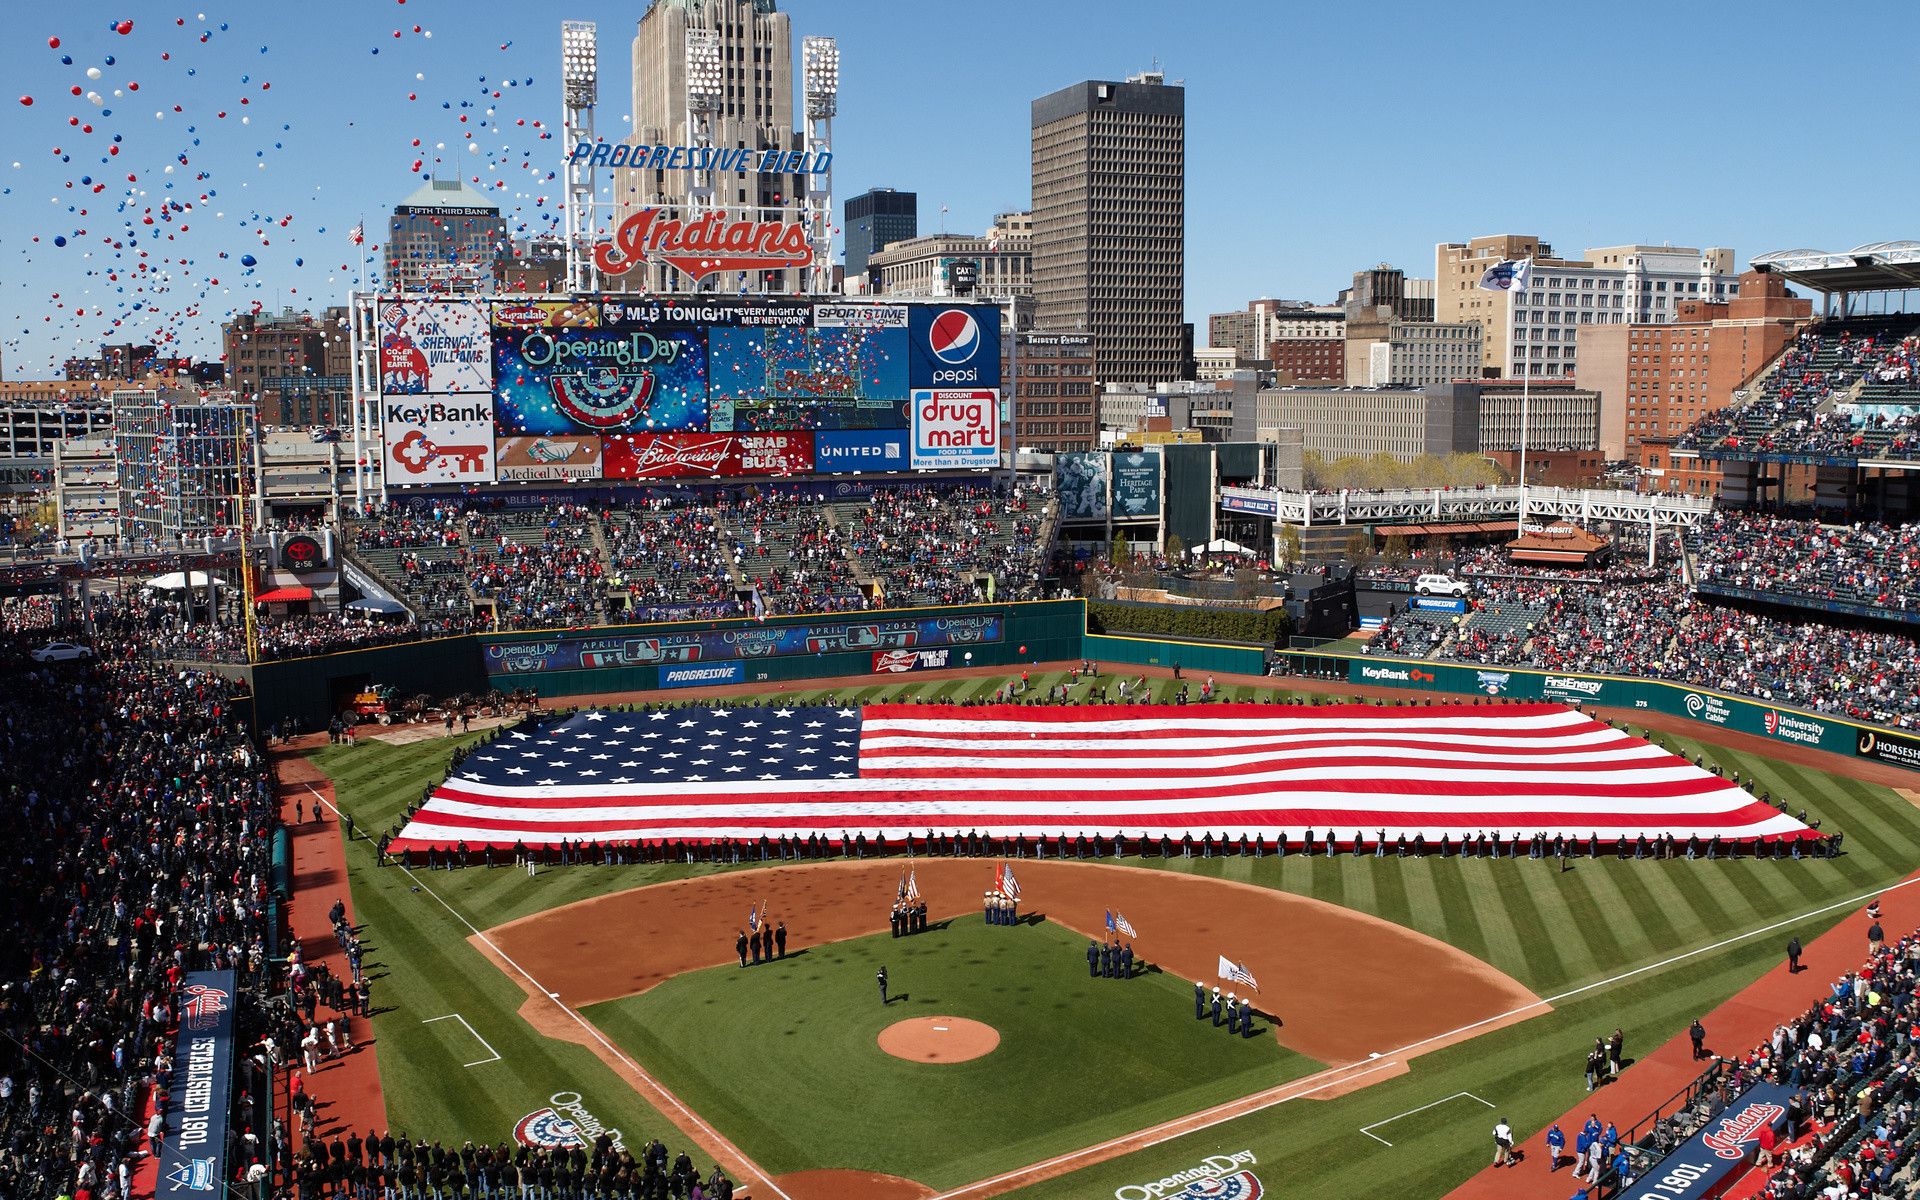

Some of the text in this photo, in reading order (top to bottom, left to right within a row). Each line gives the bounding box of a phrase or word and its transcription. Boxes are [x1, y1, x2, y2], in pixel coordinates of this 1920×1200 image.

[569, 143, 833, 174] PROGRESSIVE FIELD
[435, 207, 463, 215] THIRD
[594, 207, 813, 281] Indians
[498, 309, 547, 321] Sugardale
[627, 307, 733, 320] MLB TONIGHT
[738, 308, 810, 316] EVERY NIGHT ON
[817, 308, 907, 319] SPORTSTIME
[762, 317, 806, 325] NETWORK
[417, 323, 440, 335] ASK
[423, 337, 477, 349] SHERWN-
[1027, 335, 1089, 344] THIRSTY PARROT
[933, 367, 977, 384] pepsi
[387, 404, 490, 424] KeyBank
[922, 393, 982, 428] drug
[928, 426, 992, 446] mart
[741, 437, 788, 449] GRAB
[635, 447, 730, 466] Budweiser
[821, 447, 882, 457] UNITED
[913, 458, 932, 466] More
[962, 458, 998, 466] Drugstore
[505, 466, 596, 480] Medical Mutual
[1120, 478, 1152, 487] HERITAGE
[1130, 485, 1146, 494] PARK
[1371, 582, 1410, 591] 2:56 PM
[808, 622, 916, 636] APRIL 2012
[582, 635, 700, 649] APRIL 2012
[920, 650, 949, 660] WALK-OFF
[929, 658, 946, 667] HERO
[666, 667, 737, 681] PROGRESSIVE
[1362, 667, 1409, 681] KeyBank
[1544, 676, 1603, 693] FirstEnergy
[1636, 700, 1648, 708] 375
[1706, 696, 1724, 706] Time
[1705, 704, 1730, 716] Warner
[1705, 712, 1725, 723] Cable
[1778, 715, 1824, 735] University
[1778, 726, 1820, 744] Hospitals
[1880, 752, 1898, 760] CASINO
[179, 1037, 216, 1150] ESTABLISHED 1901.
[1702, 1102, 1785, 1160] Indians
[1654, 1163, 1713, 1195] 1901.
